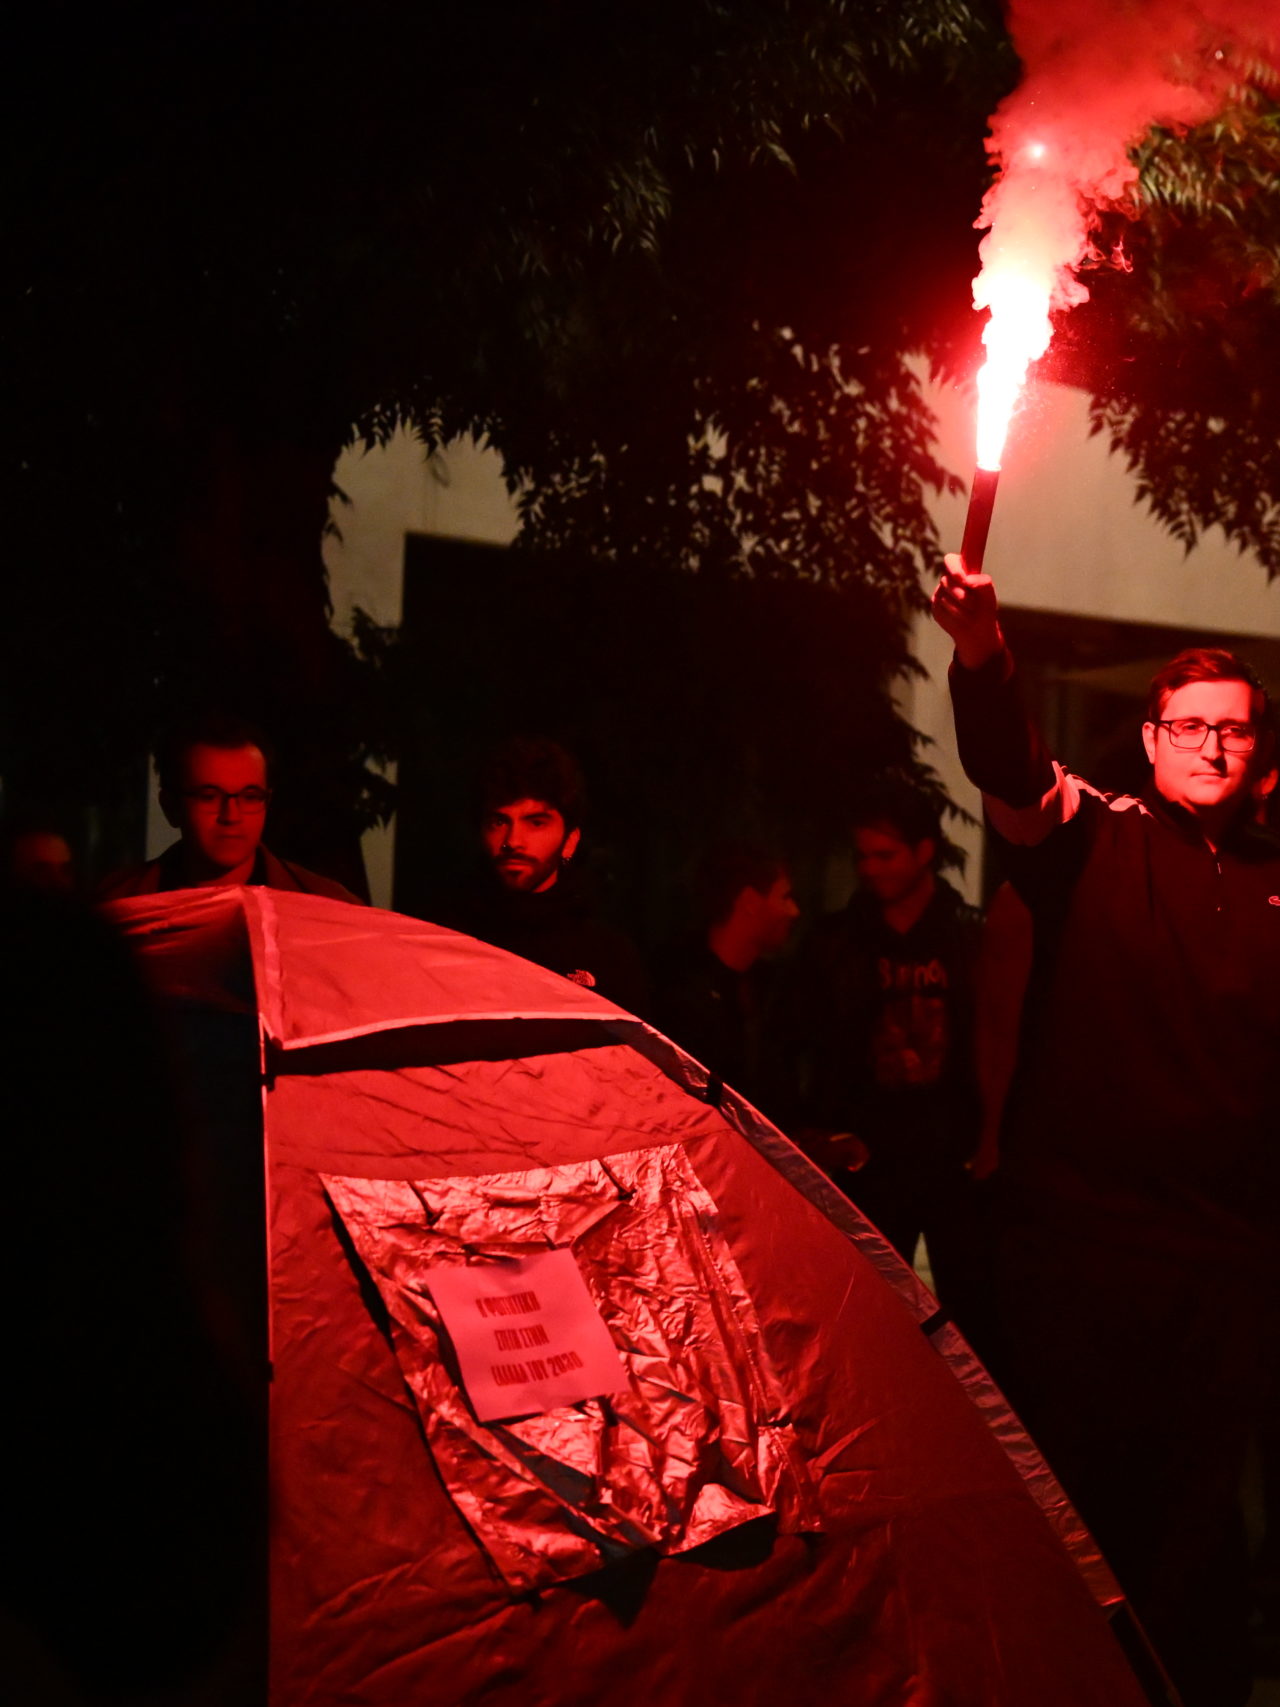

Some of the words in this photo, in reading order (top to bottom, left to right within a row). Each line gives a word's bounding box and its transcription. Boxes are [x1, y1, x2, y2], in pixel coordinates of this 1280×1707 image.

[491, 1364, 529, 1386] ΕΛΛΑΔΑ
[525, 1360, 548, 1381] ΤΟΥ
[547, 1351, 583, 1376] 2030
